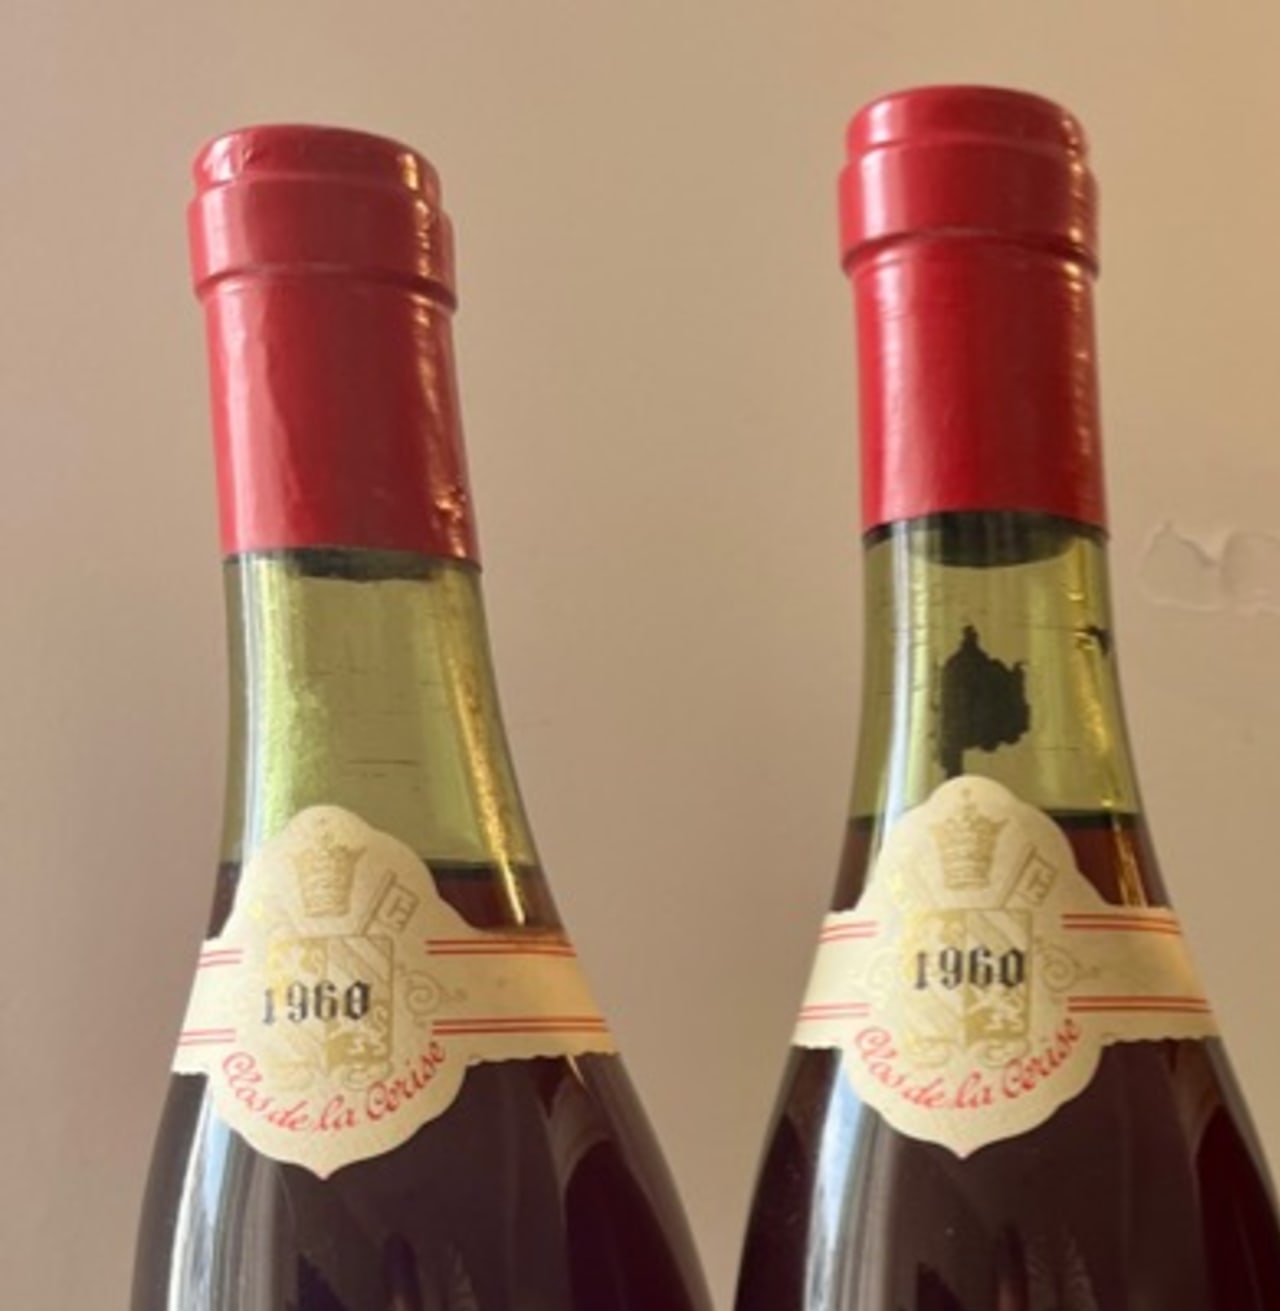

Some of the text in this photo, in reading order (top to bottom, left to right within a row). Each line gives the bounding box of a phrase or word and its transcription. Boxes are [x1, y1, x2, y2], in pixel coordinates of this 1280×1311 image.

[914, 946, 1026, 991] 1960
[262, 980, 372, 1025] 1960
[222, 1051, 272, 1124] Clos
[267, 1100, 312, 1132] de
[312, 1094, 356, 1131] la
[853, 1026, 903, 1096] Clos
[902, 1078, 947, 1110] de
[947, 1072, 995, 1110] la
